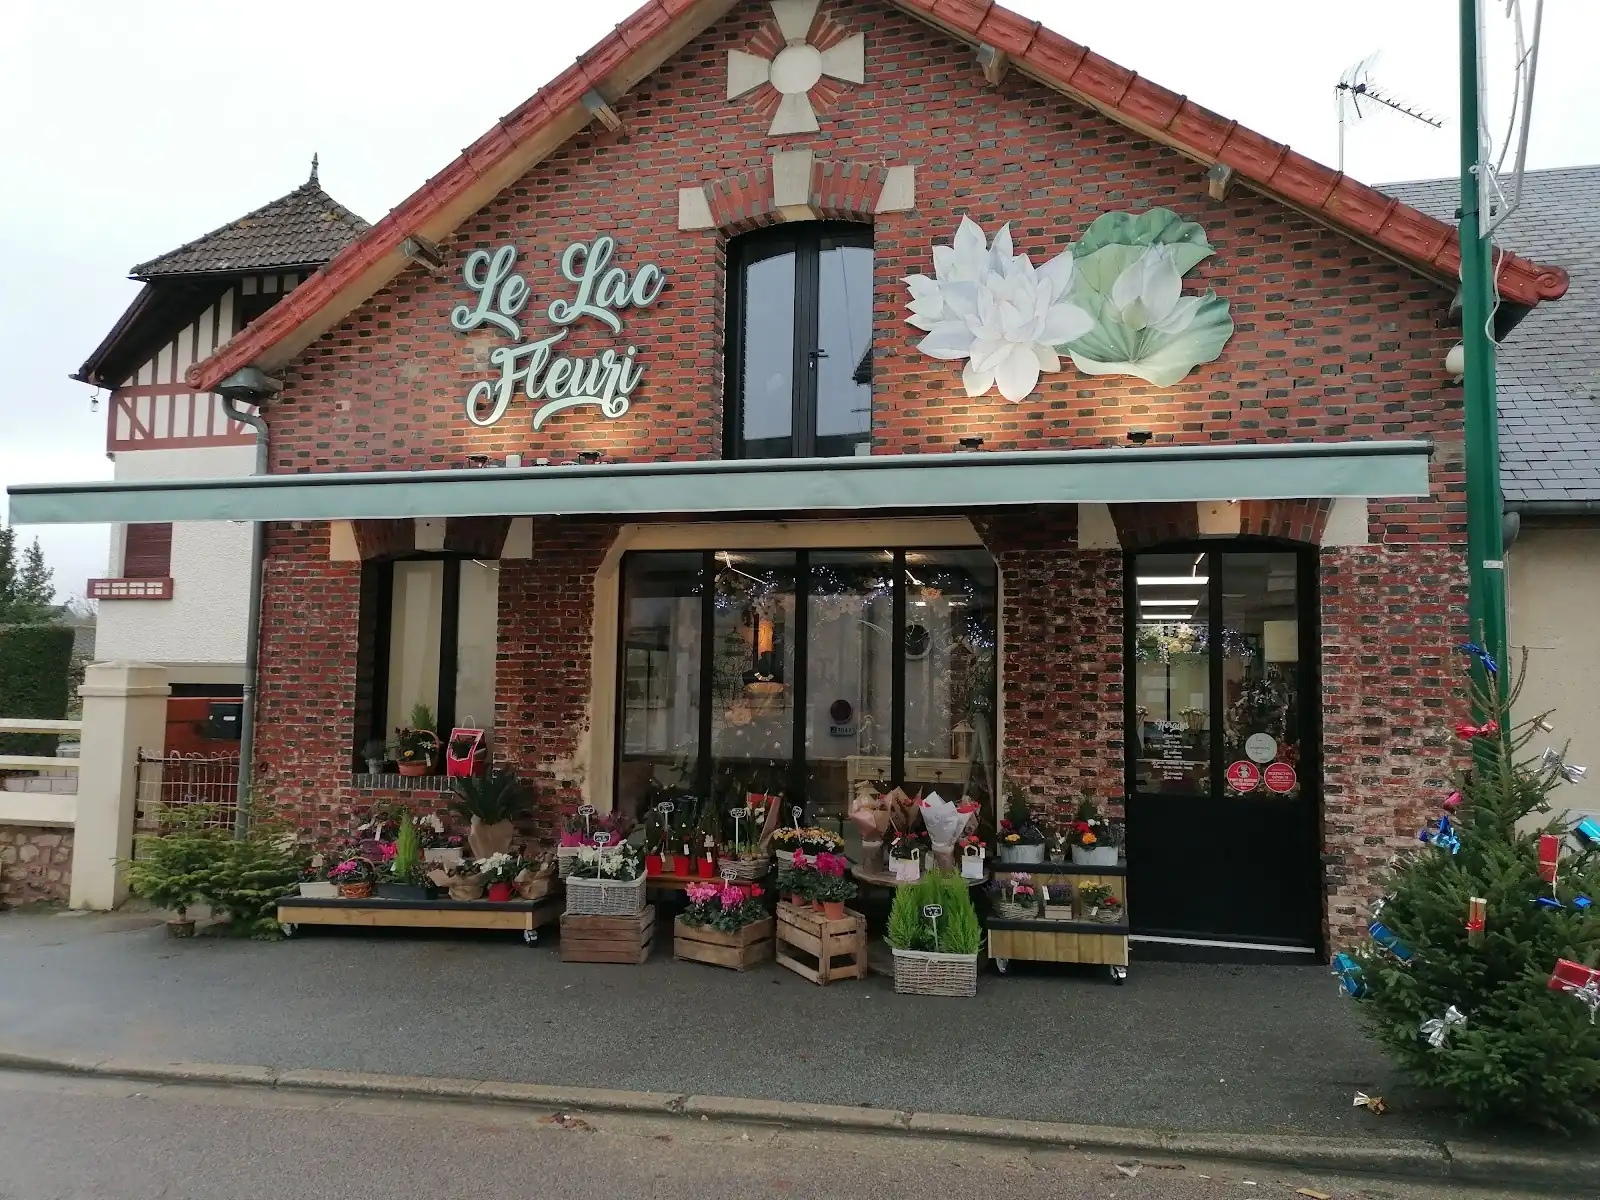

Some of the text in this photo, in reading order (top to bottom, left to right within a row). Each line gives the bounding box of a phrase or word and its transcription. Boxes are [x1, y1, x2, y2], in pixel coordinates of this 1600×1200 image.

[451, 236, 665, 341] Le Lac
[466, 328, 645, 431] Fleuri
